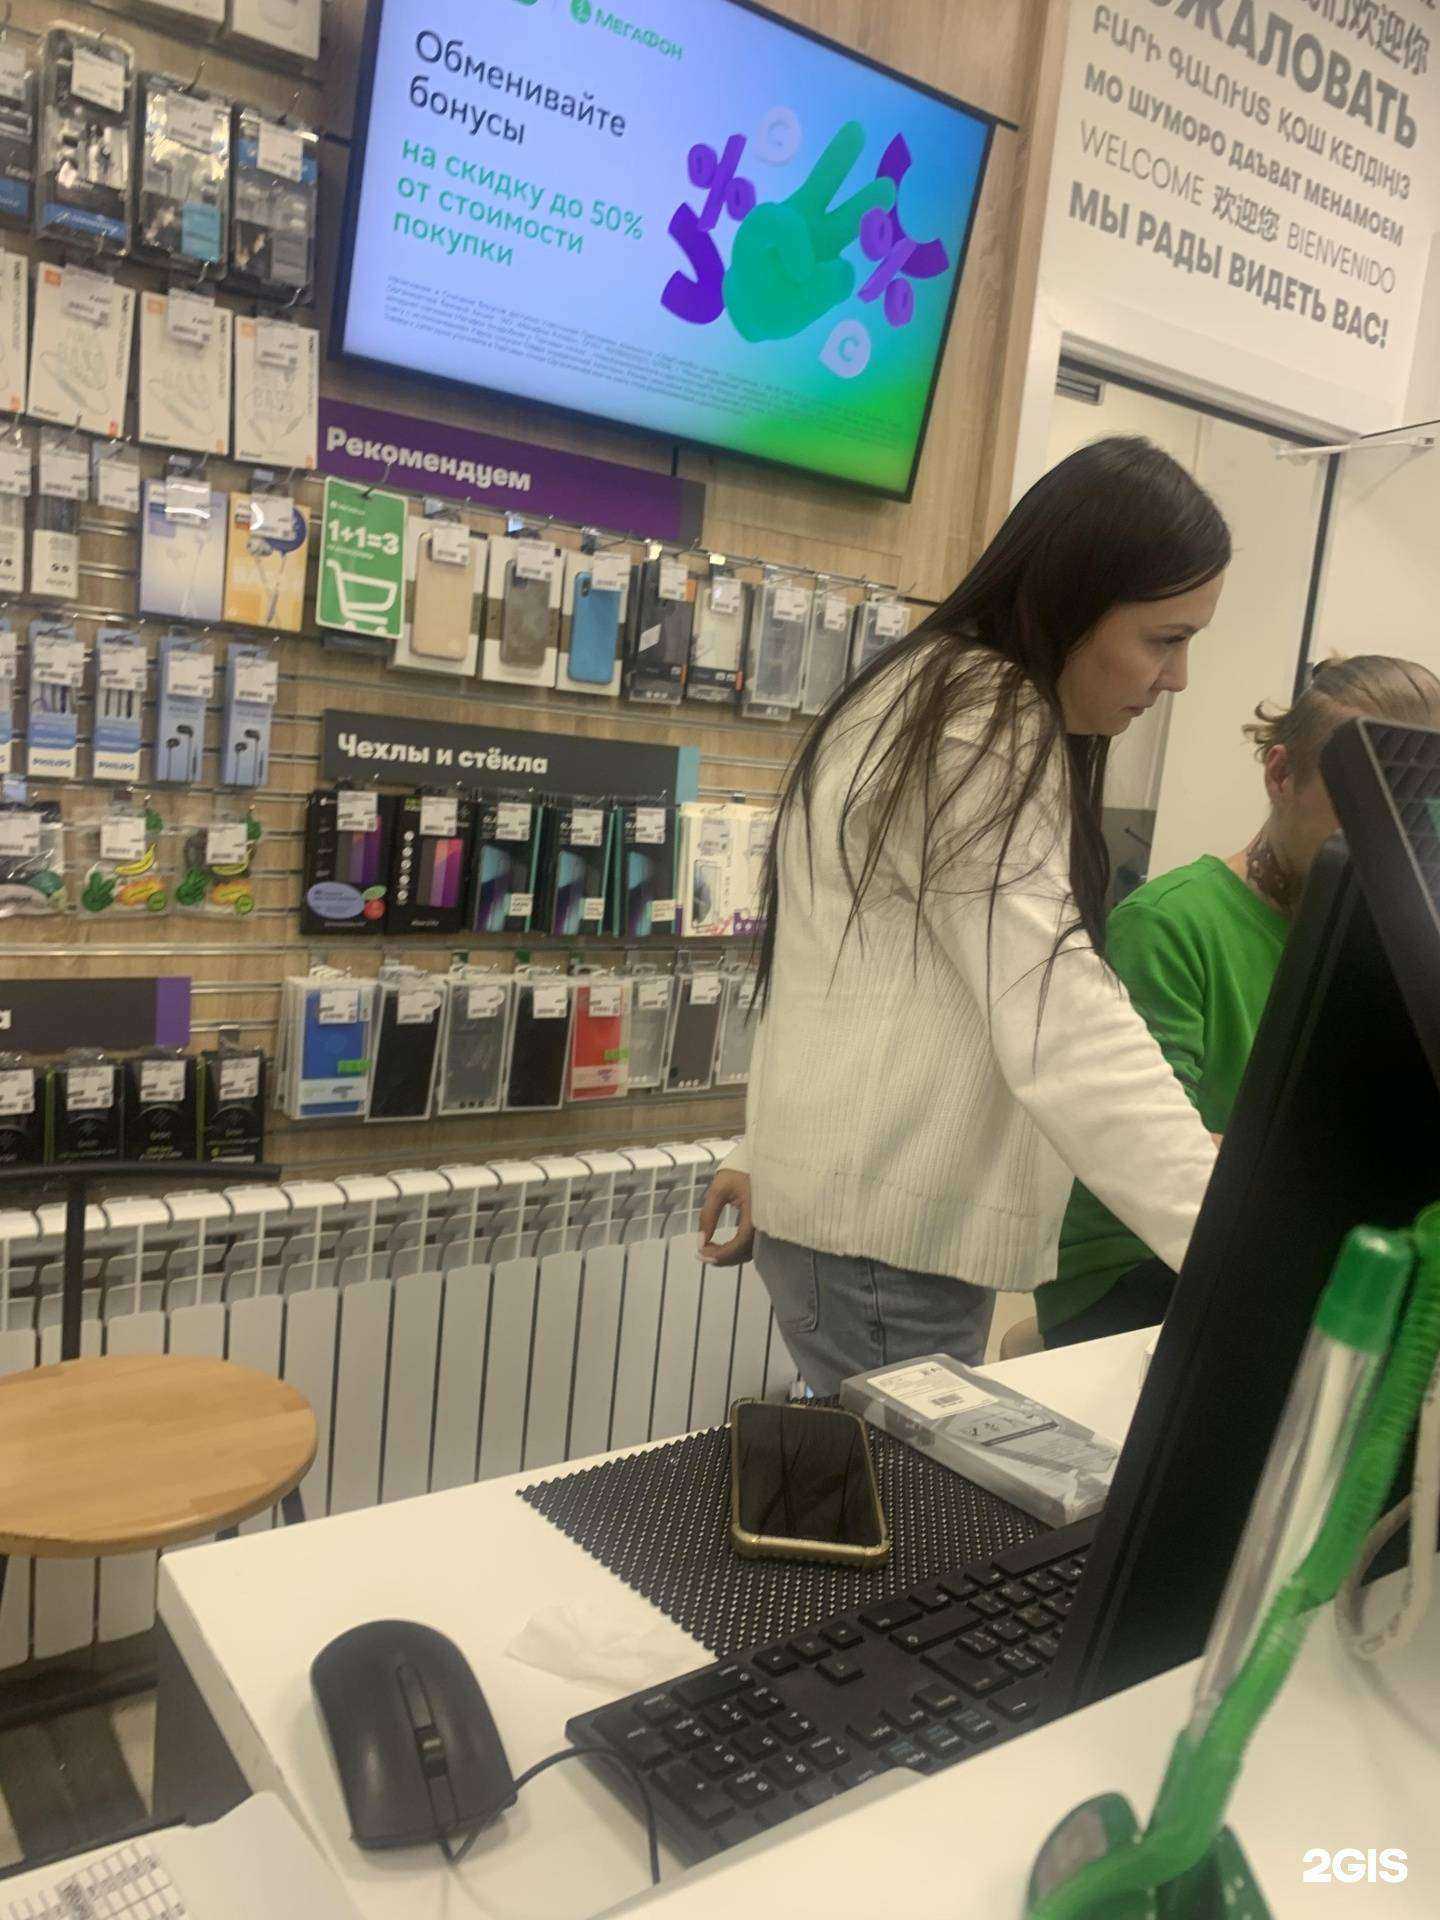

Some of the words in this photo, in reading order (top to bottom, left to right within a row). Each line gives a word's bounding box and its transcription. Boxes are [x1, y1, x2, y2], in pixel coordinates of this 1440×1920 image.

[409, 74, 526, 146] бонусы
[414, 29, 627, 138] Обменивайте
[1157, 0, 1417, 150] ЖАЛОВАТЬ
[1084, 62, 1125, 104] МО
[1128, 85, 1227, 157] ШУМОРО
[1228, 139, 1303, 195] ДАЪВАТ
[397, 176, 431, 203] от
[438, 190, 585, 255] стоимости
[402, 139, 437, 170] на
[444, 155, 545, 211] скидку
[549, 191, 584, 220] до
[589, 198, 645, 241] 50%
[1080, 118, 1205, 207] WELCOME
[1285, 221, 1397, 295] BIENVENIDO
[393, 212, 514, 267] покупки
[1068, 180, 1130, 240] МЫ
[1136, 209, 1224, 279] РАДЫ
[1227, 251, 1327, 324] ВИДЕТЬ
[1332, 297, 1390, 350] ВАС!
[326, 426, 532, 492] Рекомендуем
[328, 517, 400, 556] 1+1=3
[337, 732, 430, 764] Чехлы
[435, 748, 453, 767] и
[458, 746, 550, 775] стёкла
